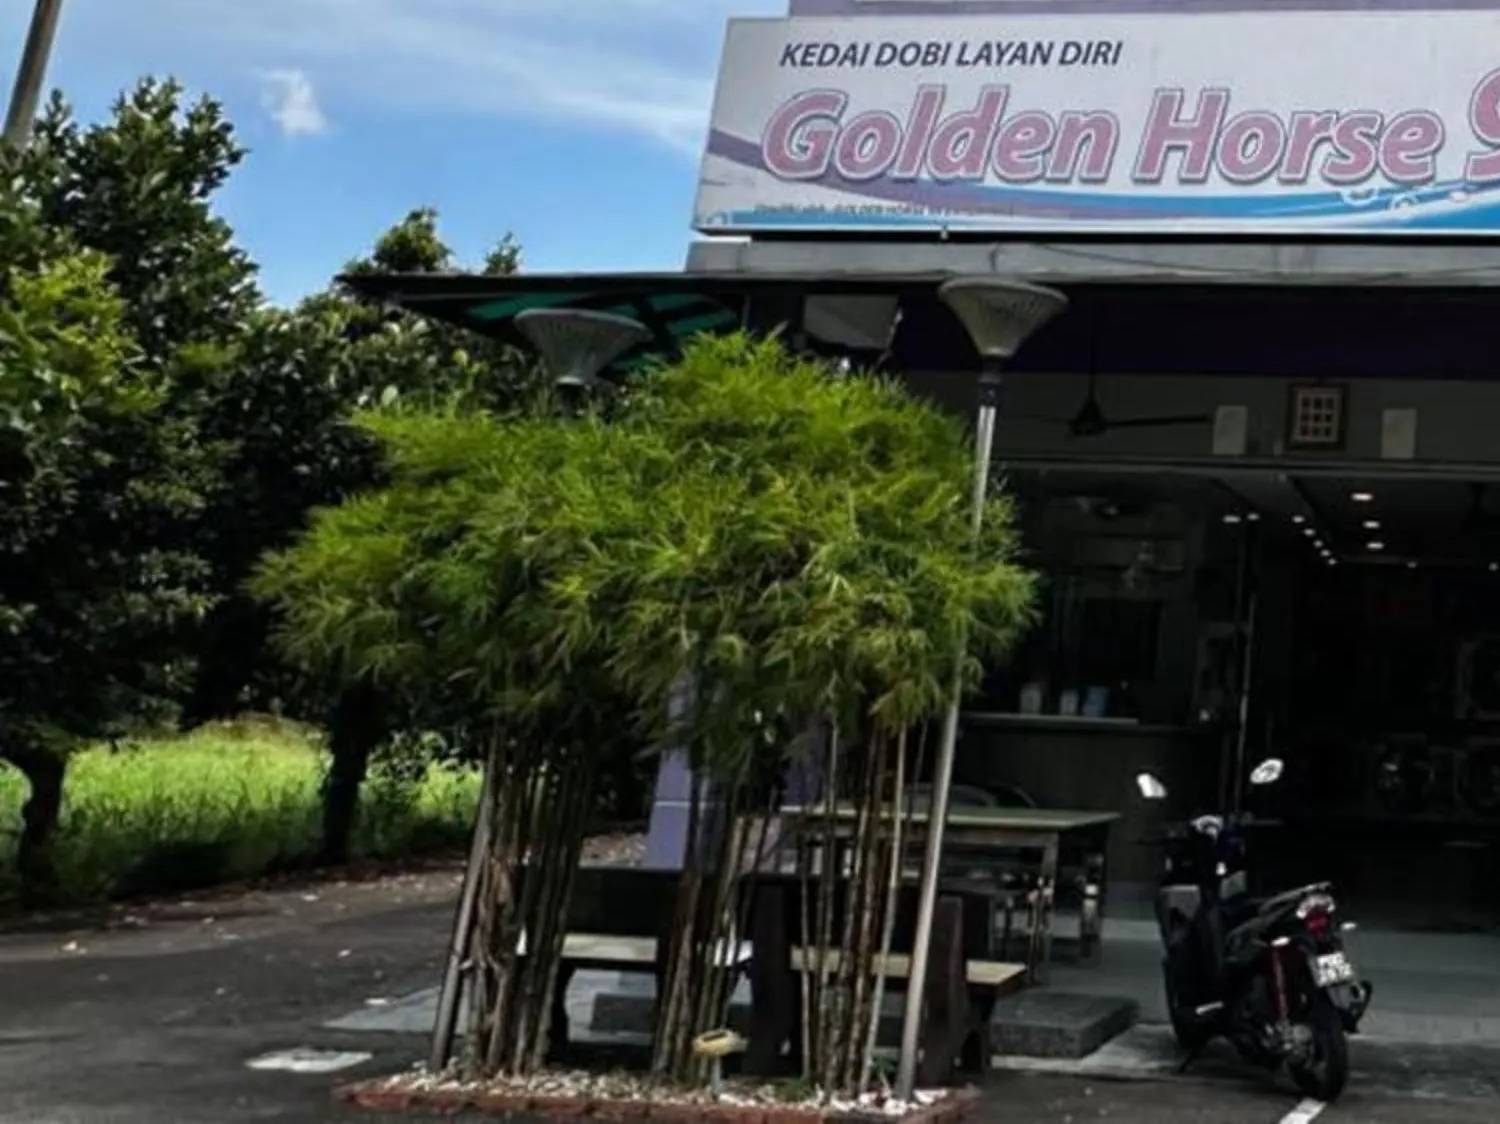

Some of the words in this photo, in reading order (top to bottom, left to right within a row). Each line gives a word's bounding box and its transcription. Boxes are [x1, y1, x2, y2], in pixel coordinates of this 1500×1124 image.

[779, 42, 870, 67] KEDAI
[874, 42, 953, 67] DOBI
[956, 41, 1053, 67] LAYAN
[1058, 40, 1123, 65] DIRI
[760, 83, 1121, 185] Golden
[1130, 85, 1446, 186] Horse
